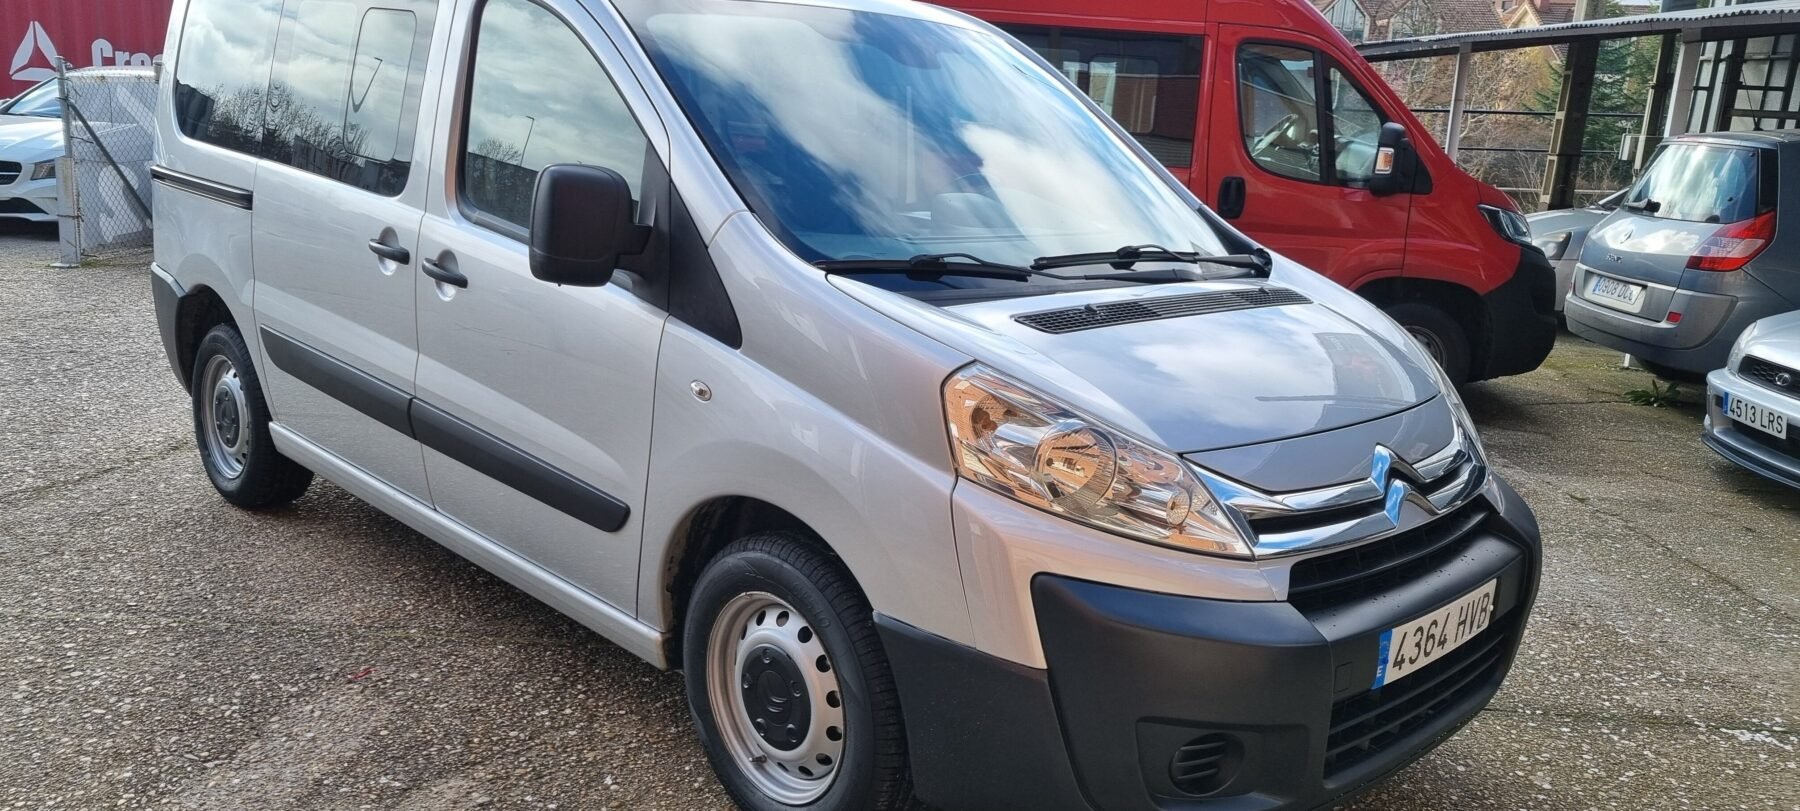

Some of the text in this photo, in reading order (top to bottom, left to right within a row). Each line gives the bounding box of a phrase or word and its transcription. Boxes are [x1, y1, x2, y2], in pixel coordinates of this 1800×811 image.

[91, 38, 163, 66] Cro
[1729, 397, 1783, 434] 4513 LRS
[1392, 592, 1490, 671] 4364 HVB
[1376, 665, 1383, 677] E
